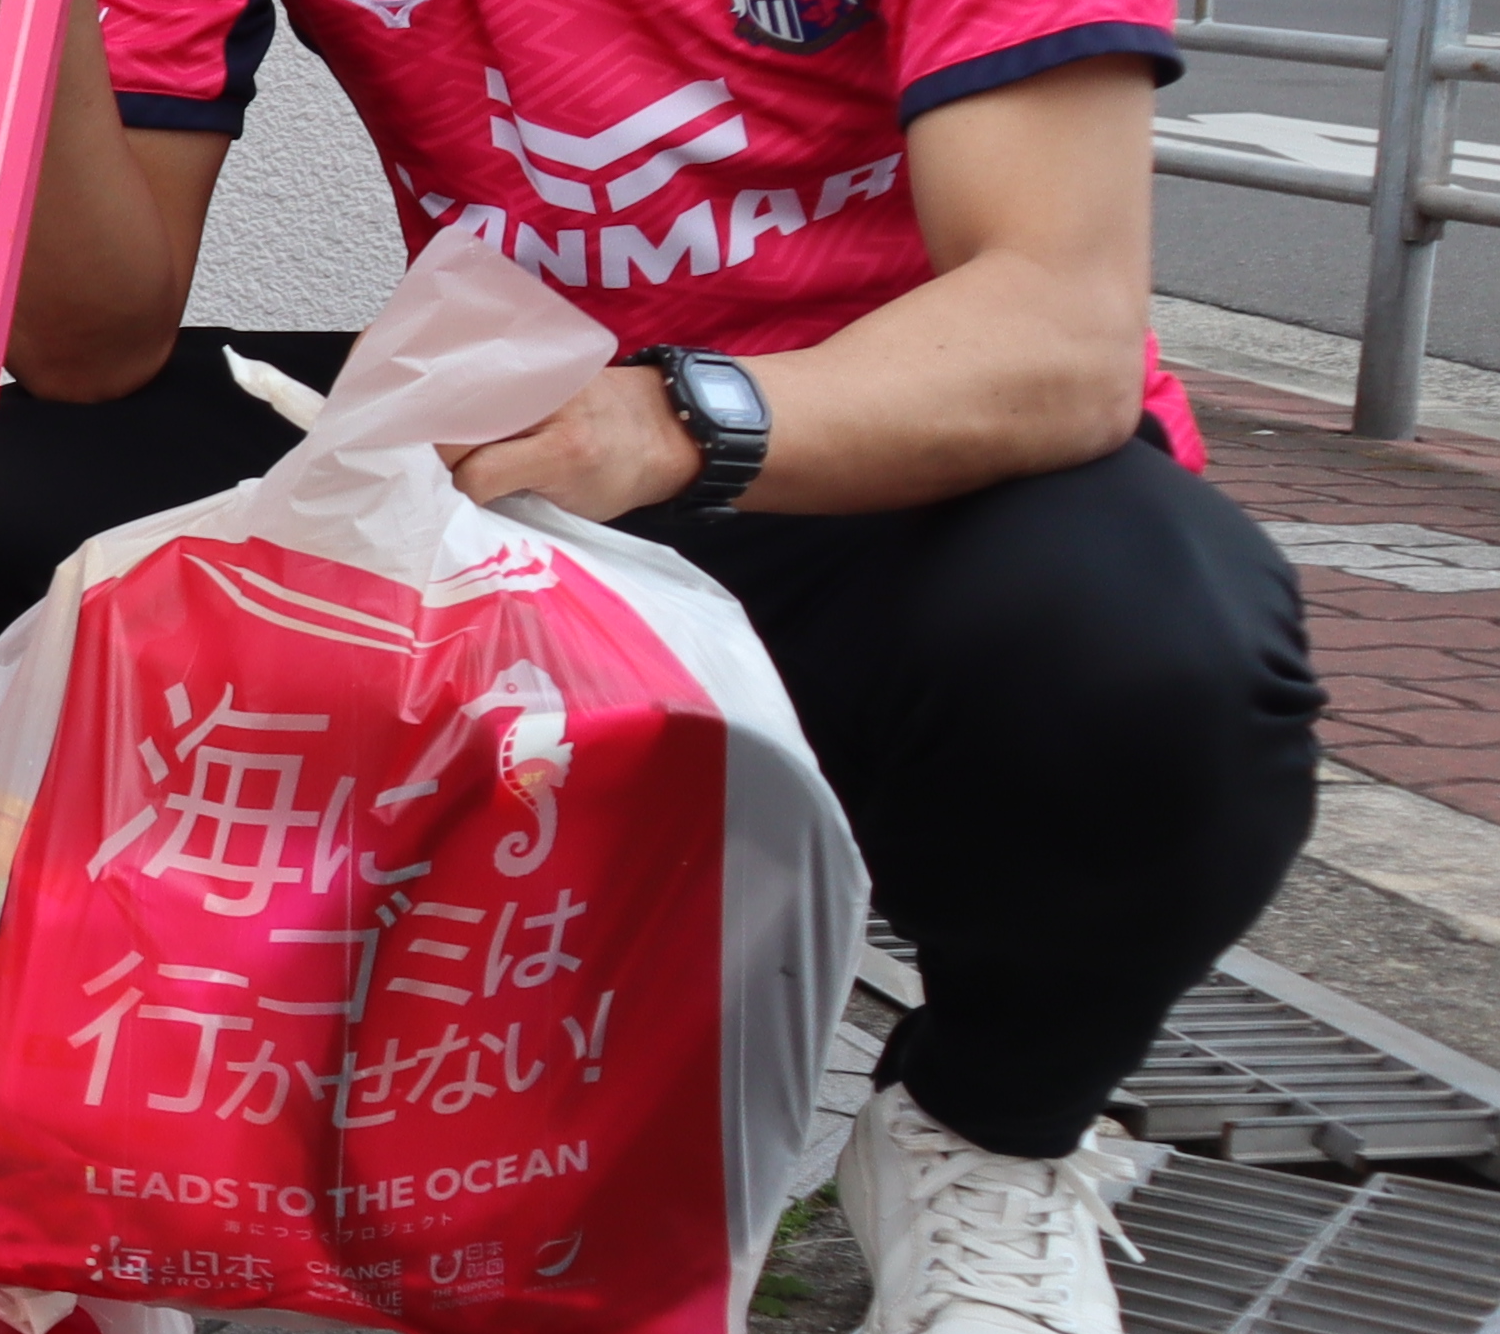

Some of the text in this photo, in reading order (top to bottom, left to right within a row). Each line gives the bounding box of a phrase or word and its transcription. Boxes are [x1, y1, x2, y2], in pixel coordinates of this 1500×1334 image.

[87, 681, 439, 917] 海に
[258, 889, 588, 1024] ゴミは
[86, 1140, 590, 1219] LEADS TO THE OCEAN
[307, 1259, 402, 1279] CHANGE
[455, 1276, 506, 1298] NIPPON
